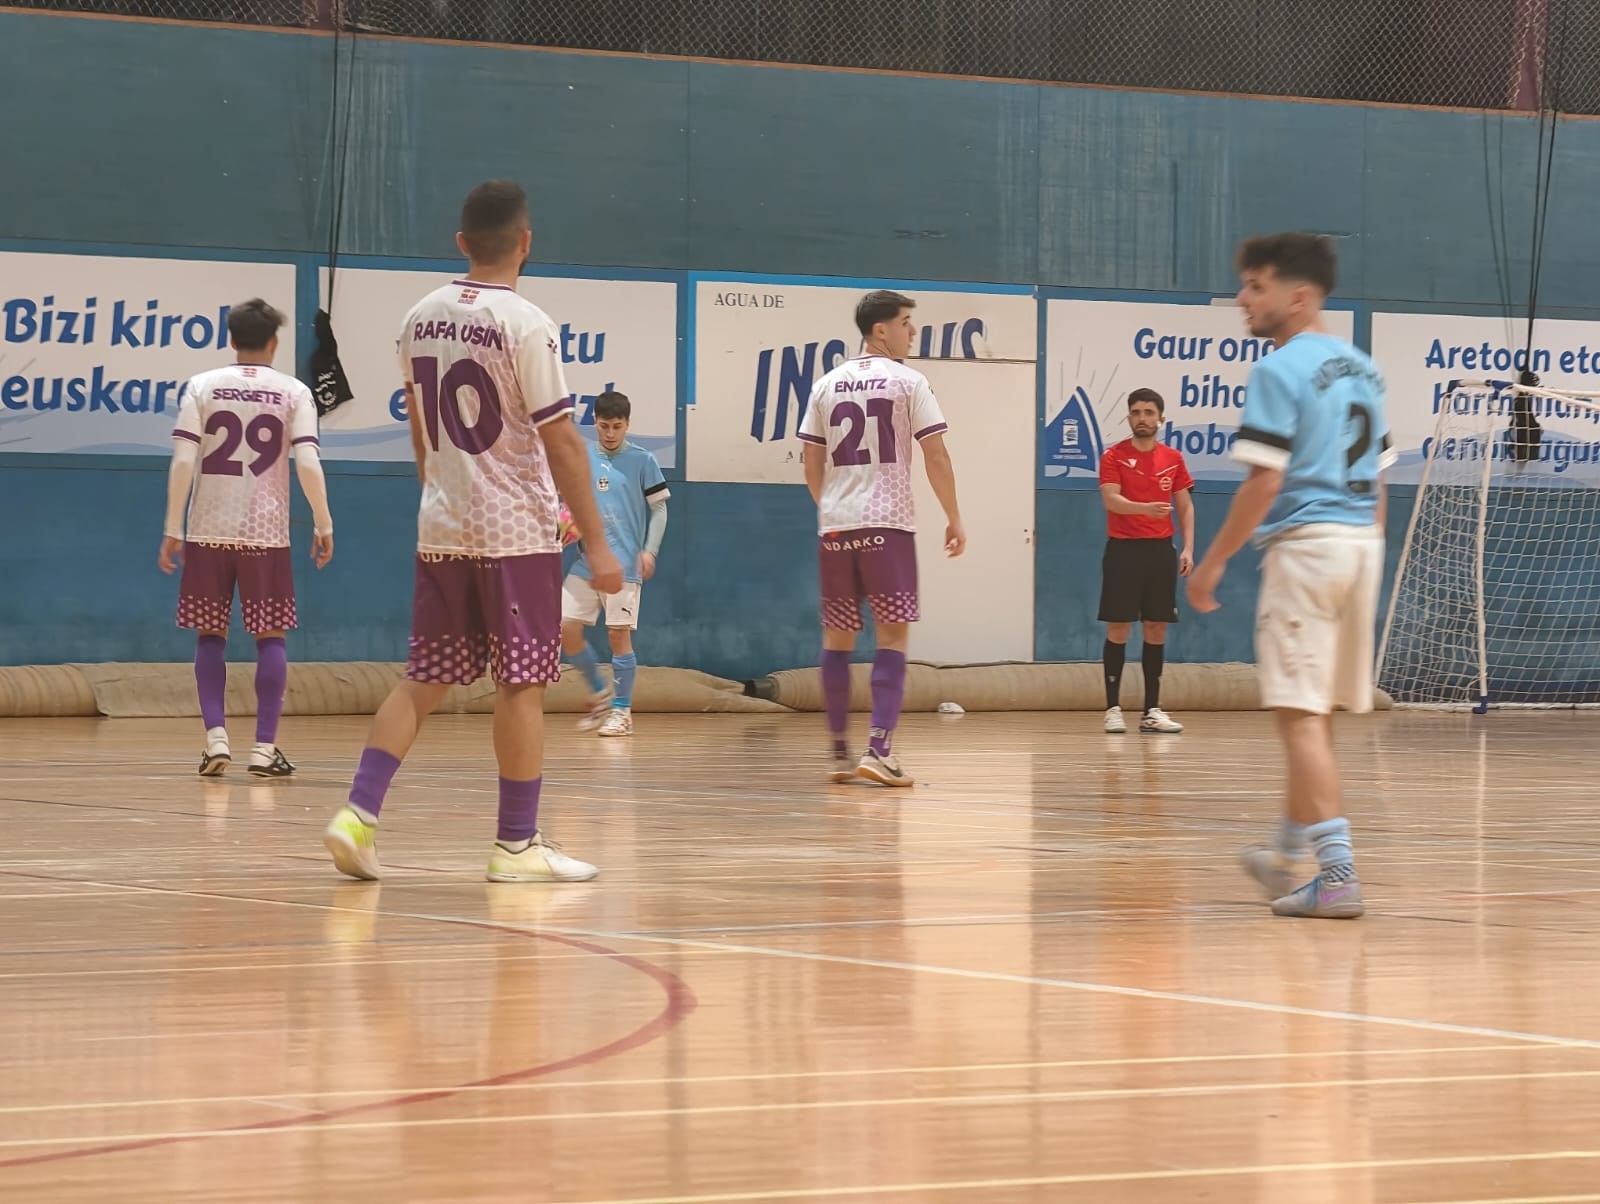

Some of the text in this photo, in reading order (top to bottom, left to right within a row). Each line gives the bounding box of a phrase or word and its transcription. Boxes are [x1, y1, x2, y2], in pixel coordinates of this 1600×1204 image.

[2, 295, 232, 350] Bizi kirol
[713, 292, 785, 309] AGUA DE
[413, 320, 457, 342] RAFA
[1134, 327, 1213, 361] Gaur
[1425, 338, 1550, 372] Aretoan
[410, 355, 504, 456] 10
[834, 378, 888, 394] ENAITZ
[200, 409, 284, 478] 29
[829, 397, 897, 468] 21
[1347, 403, 1372, 493] 2
